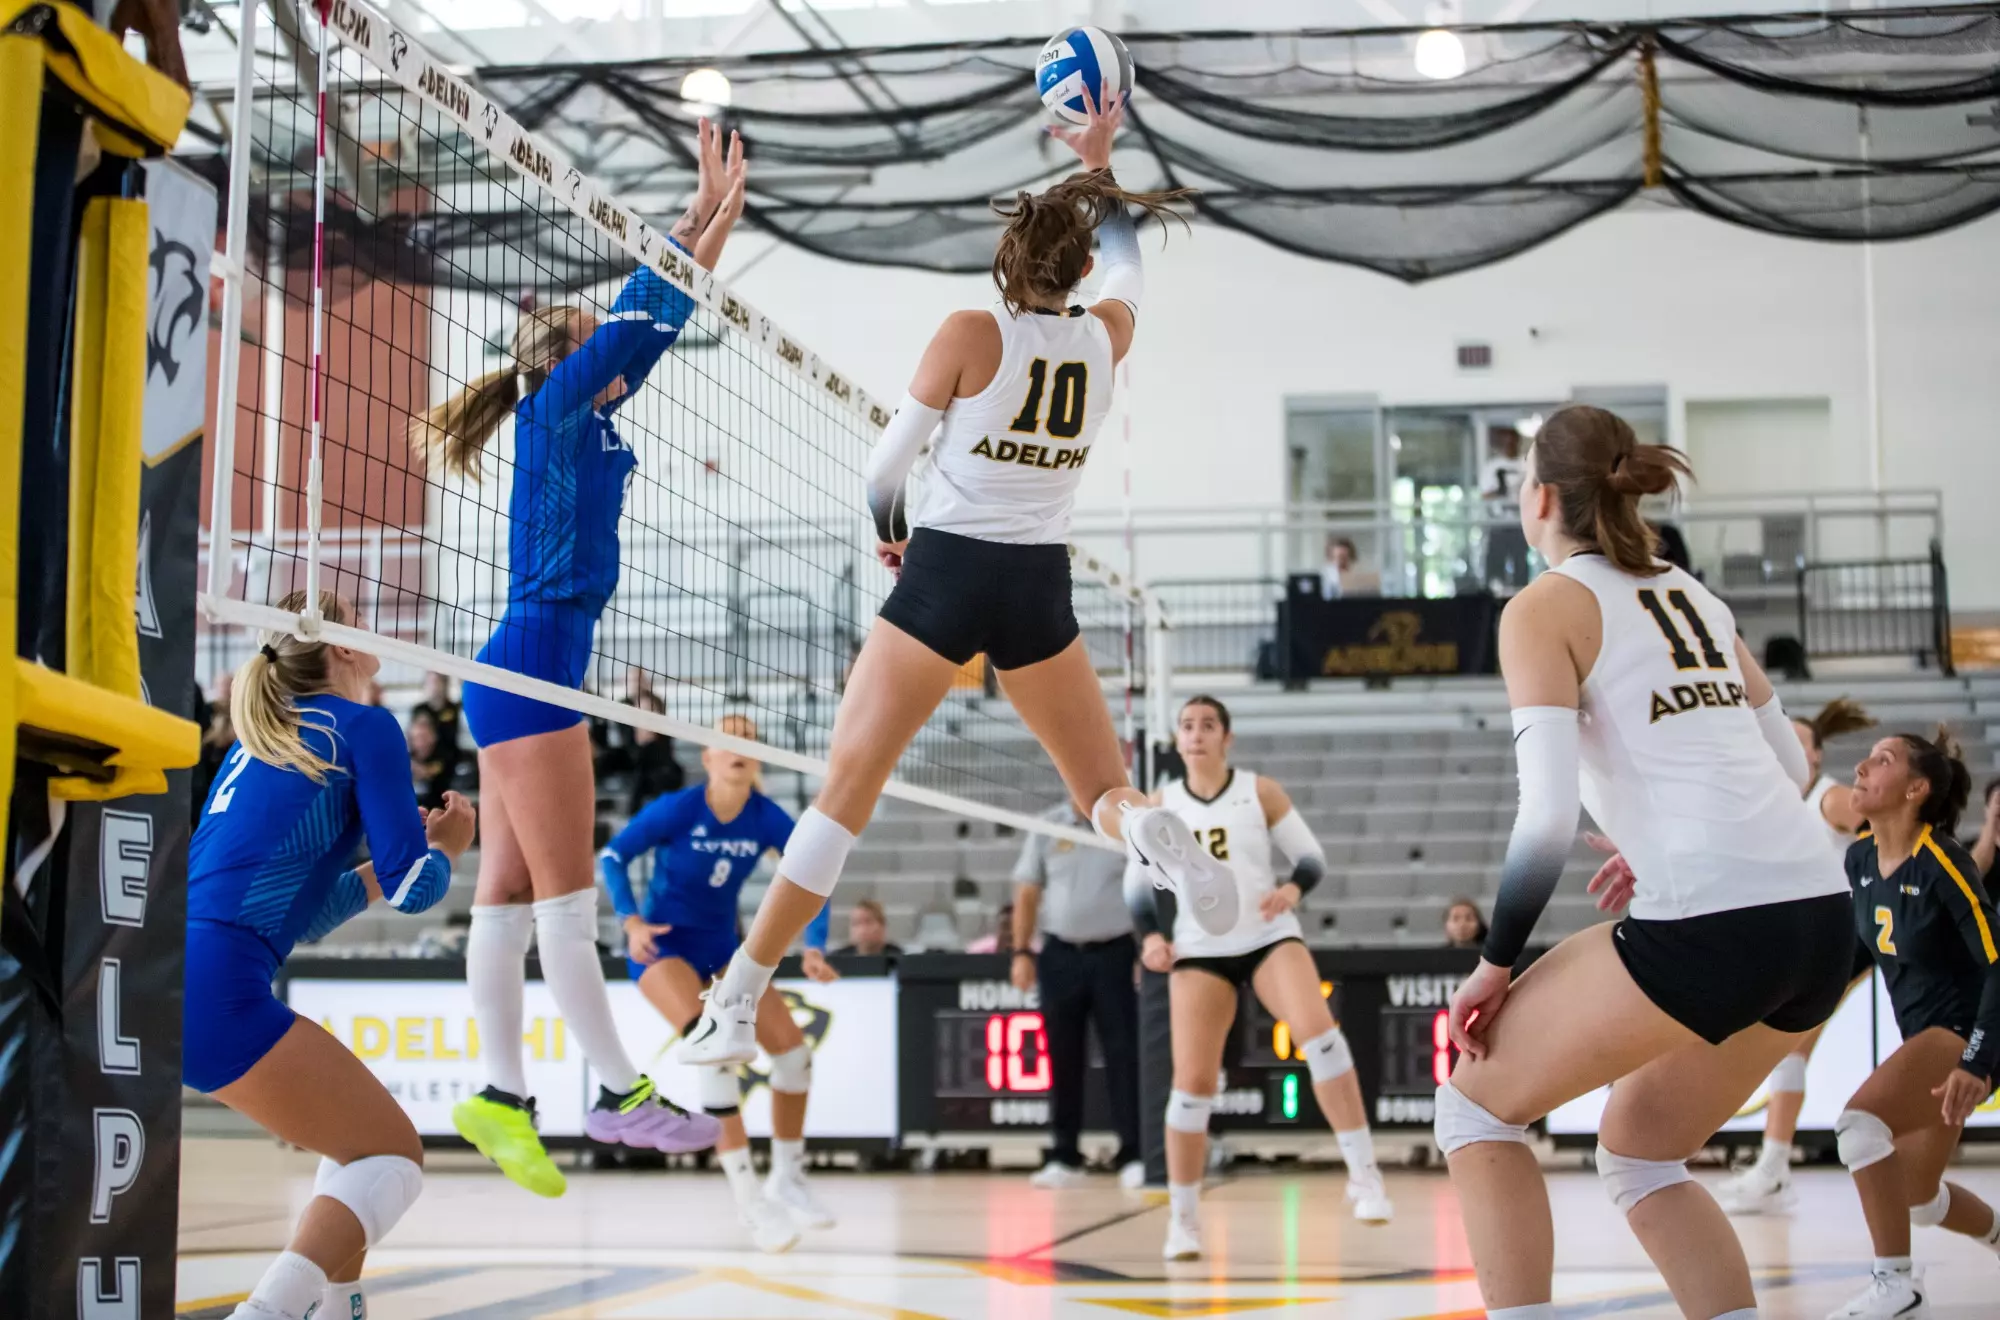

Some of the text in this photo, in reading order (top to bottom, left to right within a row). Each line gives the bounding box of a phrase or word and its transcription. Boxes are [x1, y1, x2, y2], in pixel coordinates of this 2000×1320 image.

[418, 60, 470, 121] ADELPHI
[509, 136, 553, 187] ADELPHI
[588, 191, 628, 242] ADELPHI
[1008, 356, 1088, 439] 10
[1637, 588, 1728, 671] 11
[208, 746, 252, 814] 2
[691, 840, 758, 857] LYNN
[708, 857, 732, 888] 8
[1874, 904, 1898, 956] 2
[959, 979, 1041, 1011] HOME
[1387, 974, 1466, 1007] VISIT
[985, 1011, 1053, 1093] 10
[990, 1100, 1049, 1125] BONU
[1377, 1097, 1435, 1122] BONU
